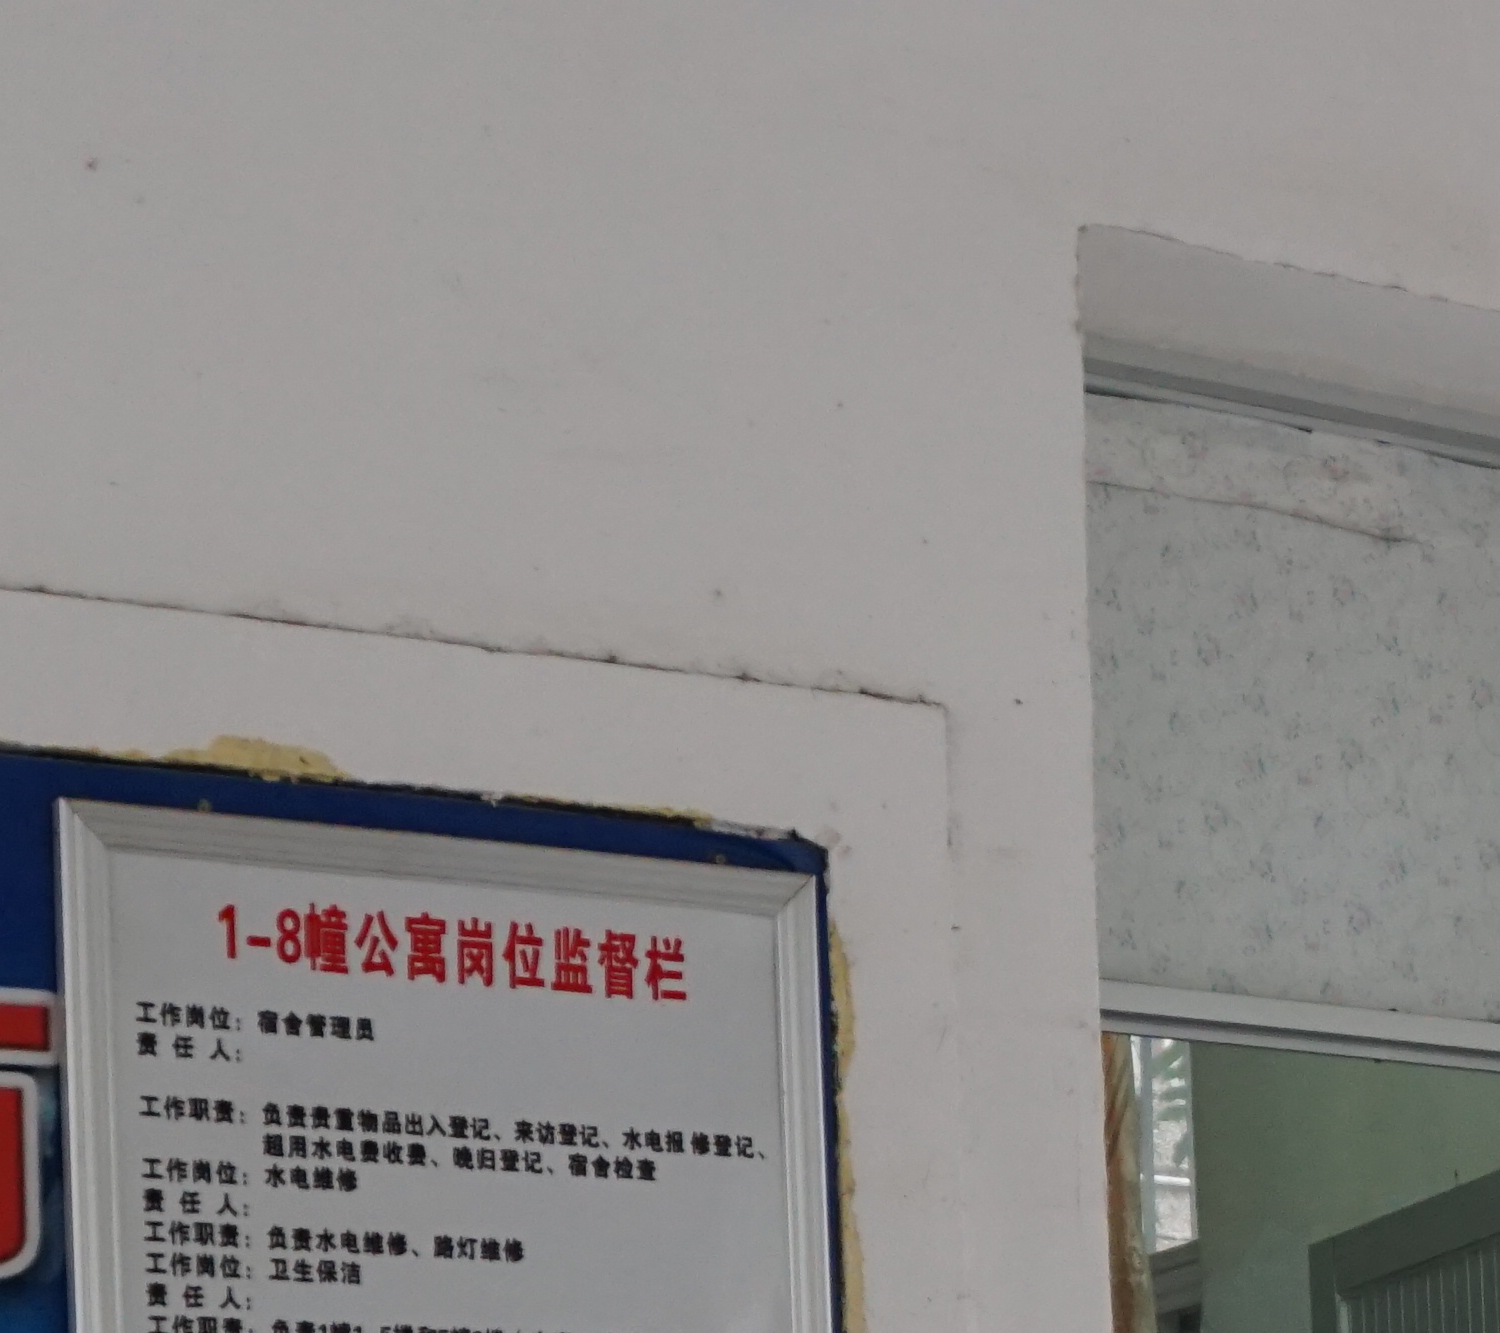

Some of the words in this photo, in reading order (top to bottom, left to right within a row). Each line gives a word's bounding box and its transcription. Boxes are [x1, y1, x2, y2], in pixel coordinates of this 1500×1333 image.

[218, 902, 689, 1002] 1-8幢公寓岗位监督栏
